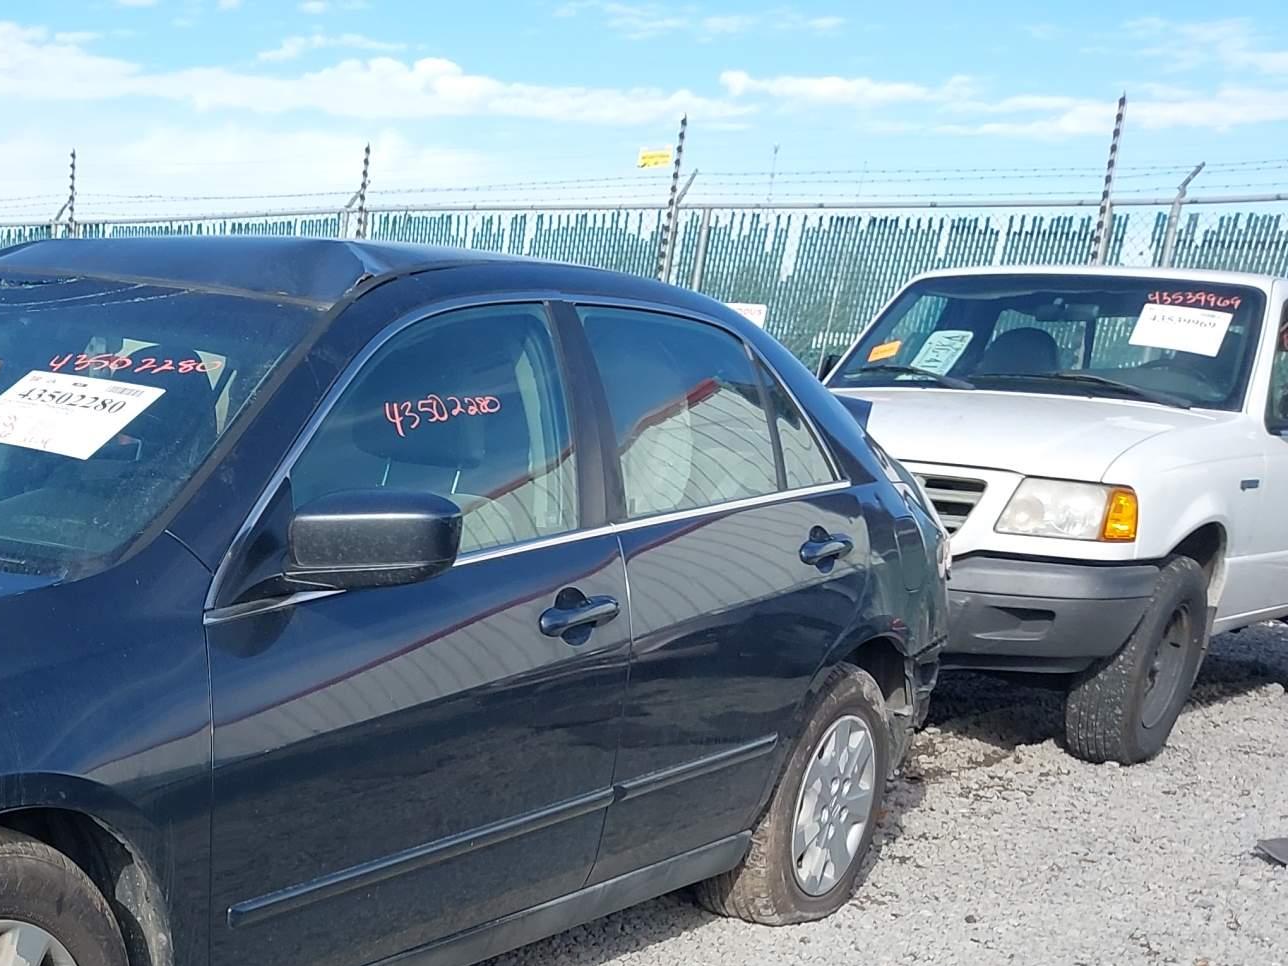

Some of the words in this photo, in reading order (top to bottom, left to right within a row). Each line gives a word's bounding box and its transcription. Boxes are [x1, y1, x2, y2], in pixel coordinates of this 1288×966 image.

[1147, 291, 1241, 309] 43539969
[49, 353, 223, 374] 43502280
[18, 388, 127, 414] 43502280
[384, 394, 501, 437] 43502280
